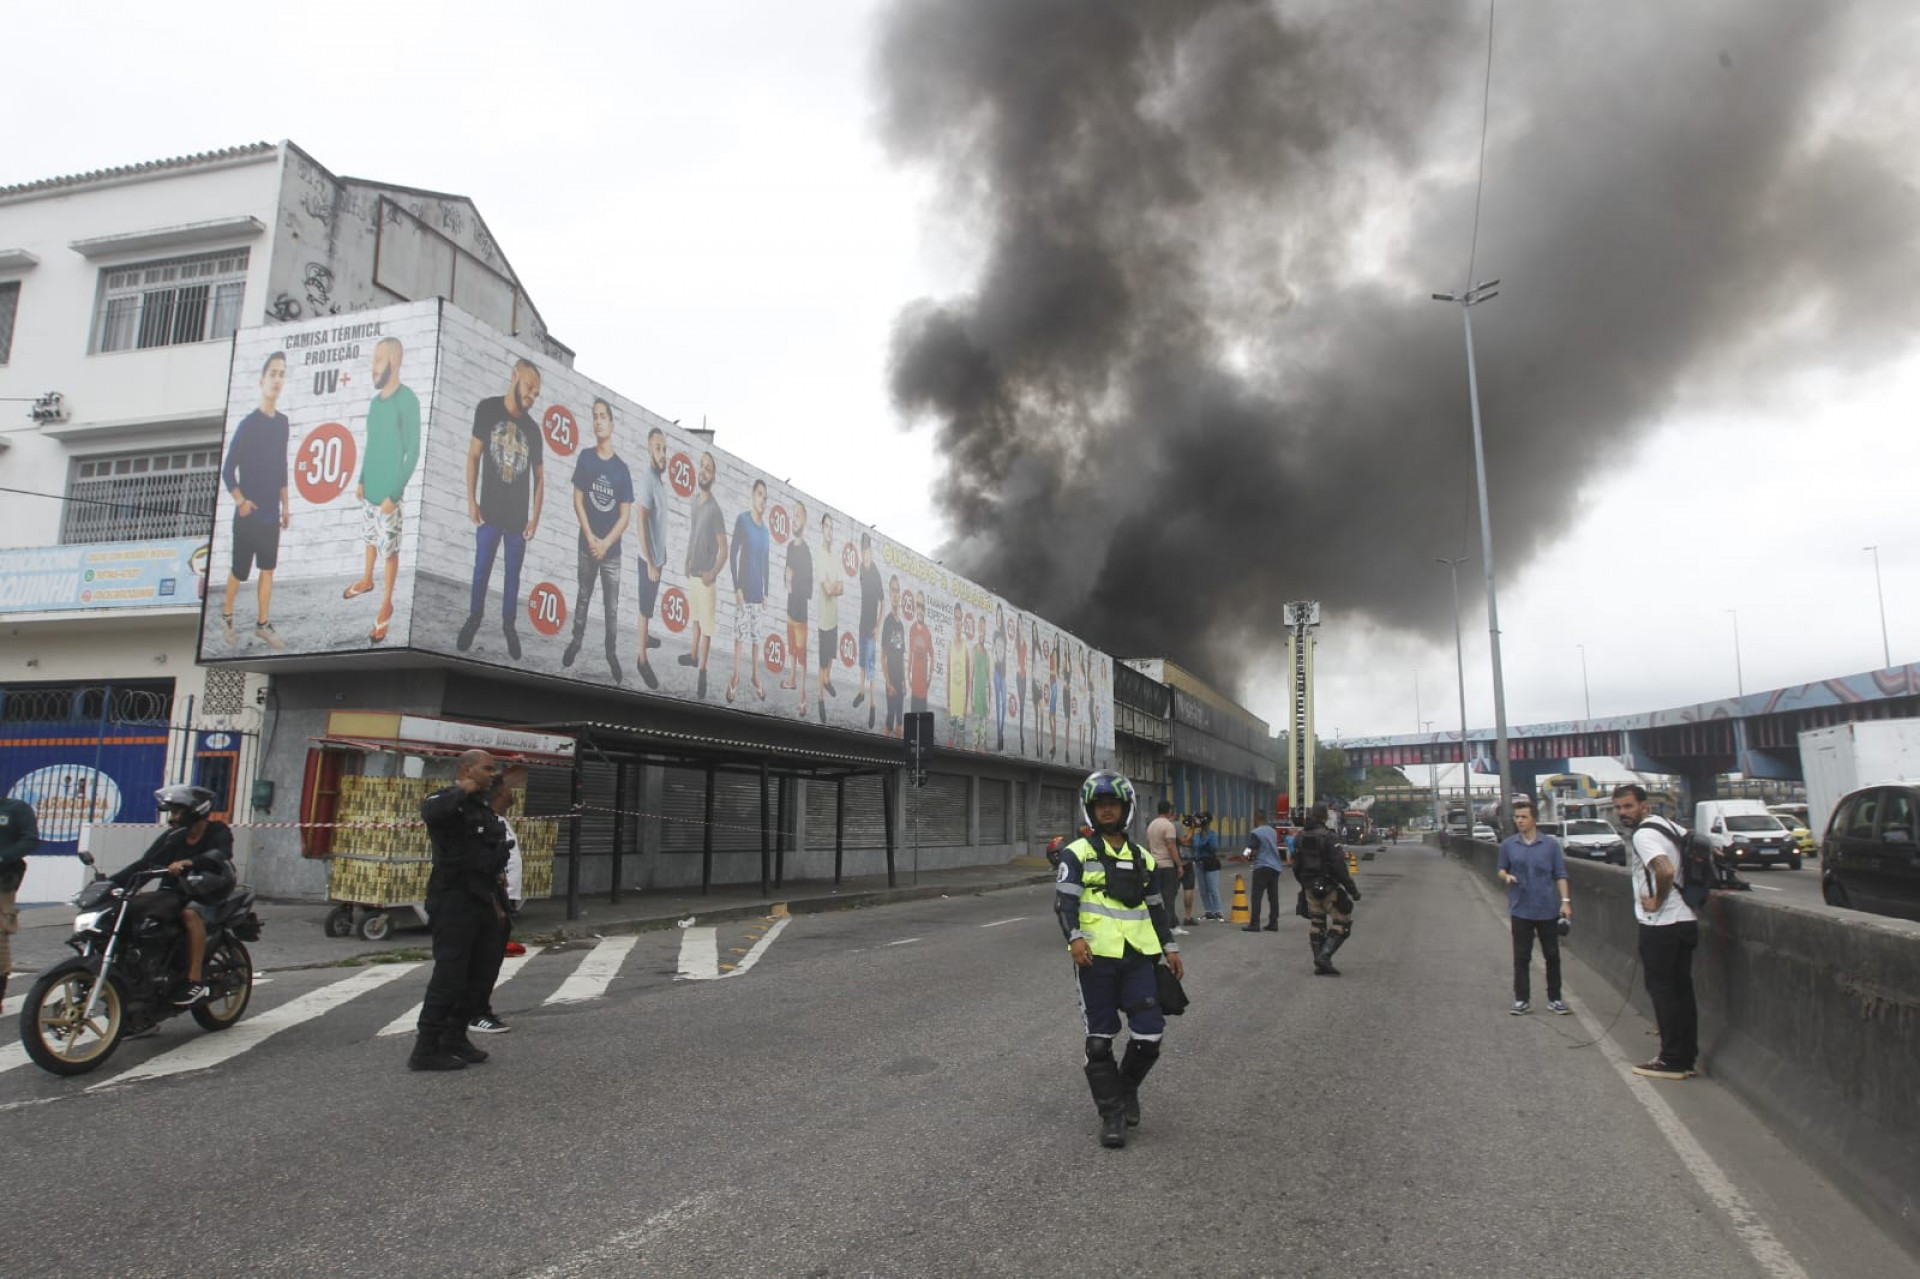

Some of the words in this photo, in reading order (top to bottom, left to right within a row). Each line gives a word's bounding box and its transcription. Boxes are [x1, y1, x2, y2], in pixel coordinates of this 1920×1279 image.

[285, 329, 328, 349] CAMISA
[331, 321, 381, 342] TÉRMICA
[304, 343, 360, 366] PROTEÇÃO
